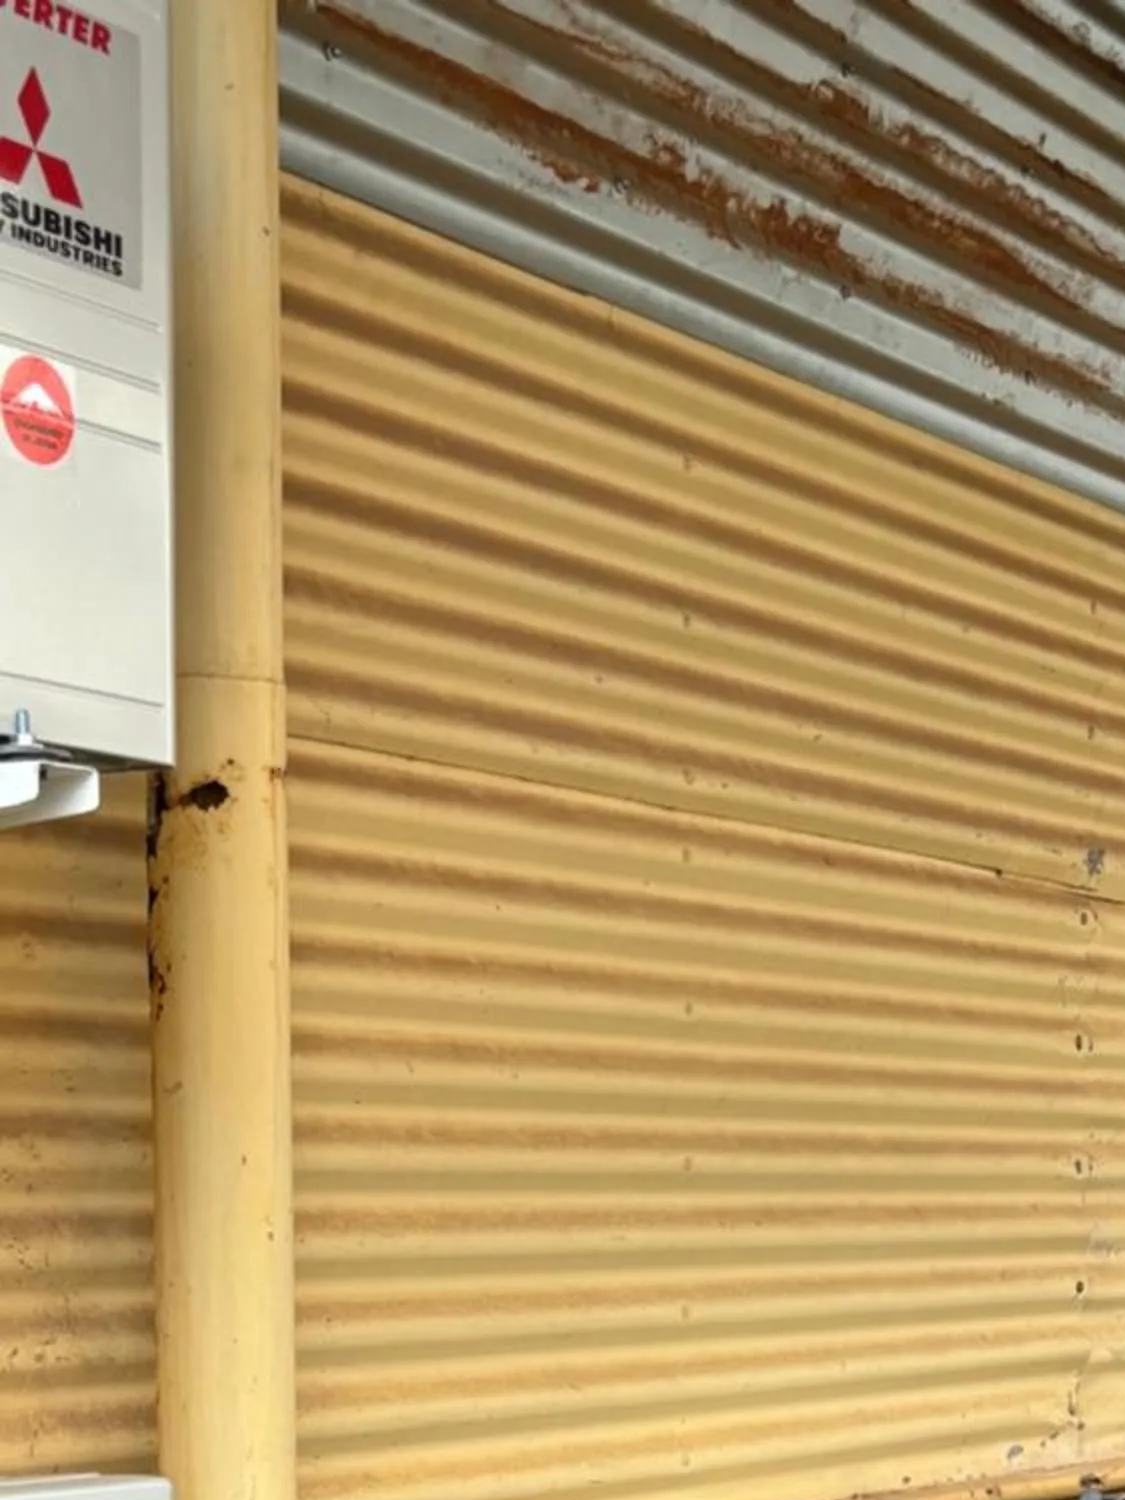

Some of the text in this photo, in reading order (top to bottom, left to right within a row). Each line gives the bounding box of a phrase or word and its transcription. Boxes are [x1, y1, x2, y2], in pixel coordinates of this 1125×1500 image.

[0, 0, 111, 55] ERTER
[1, 192, 123, 259] SUBISHI
[11, 222, 123, 277] INDUSTRIES
